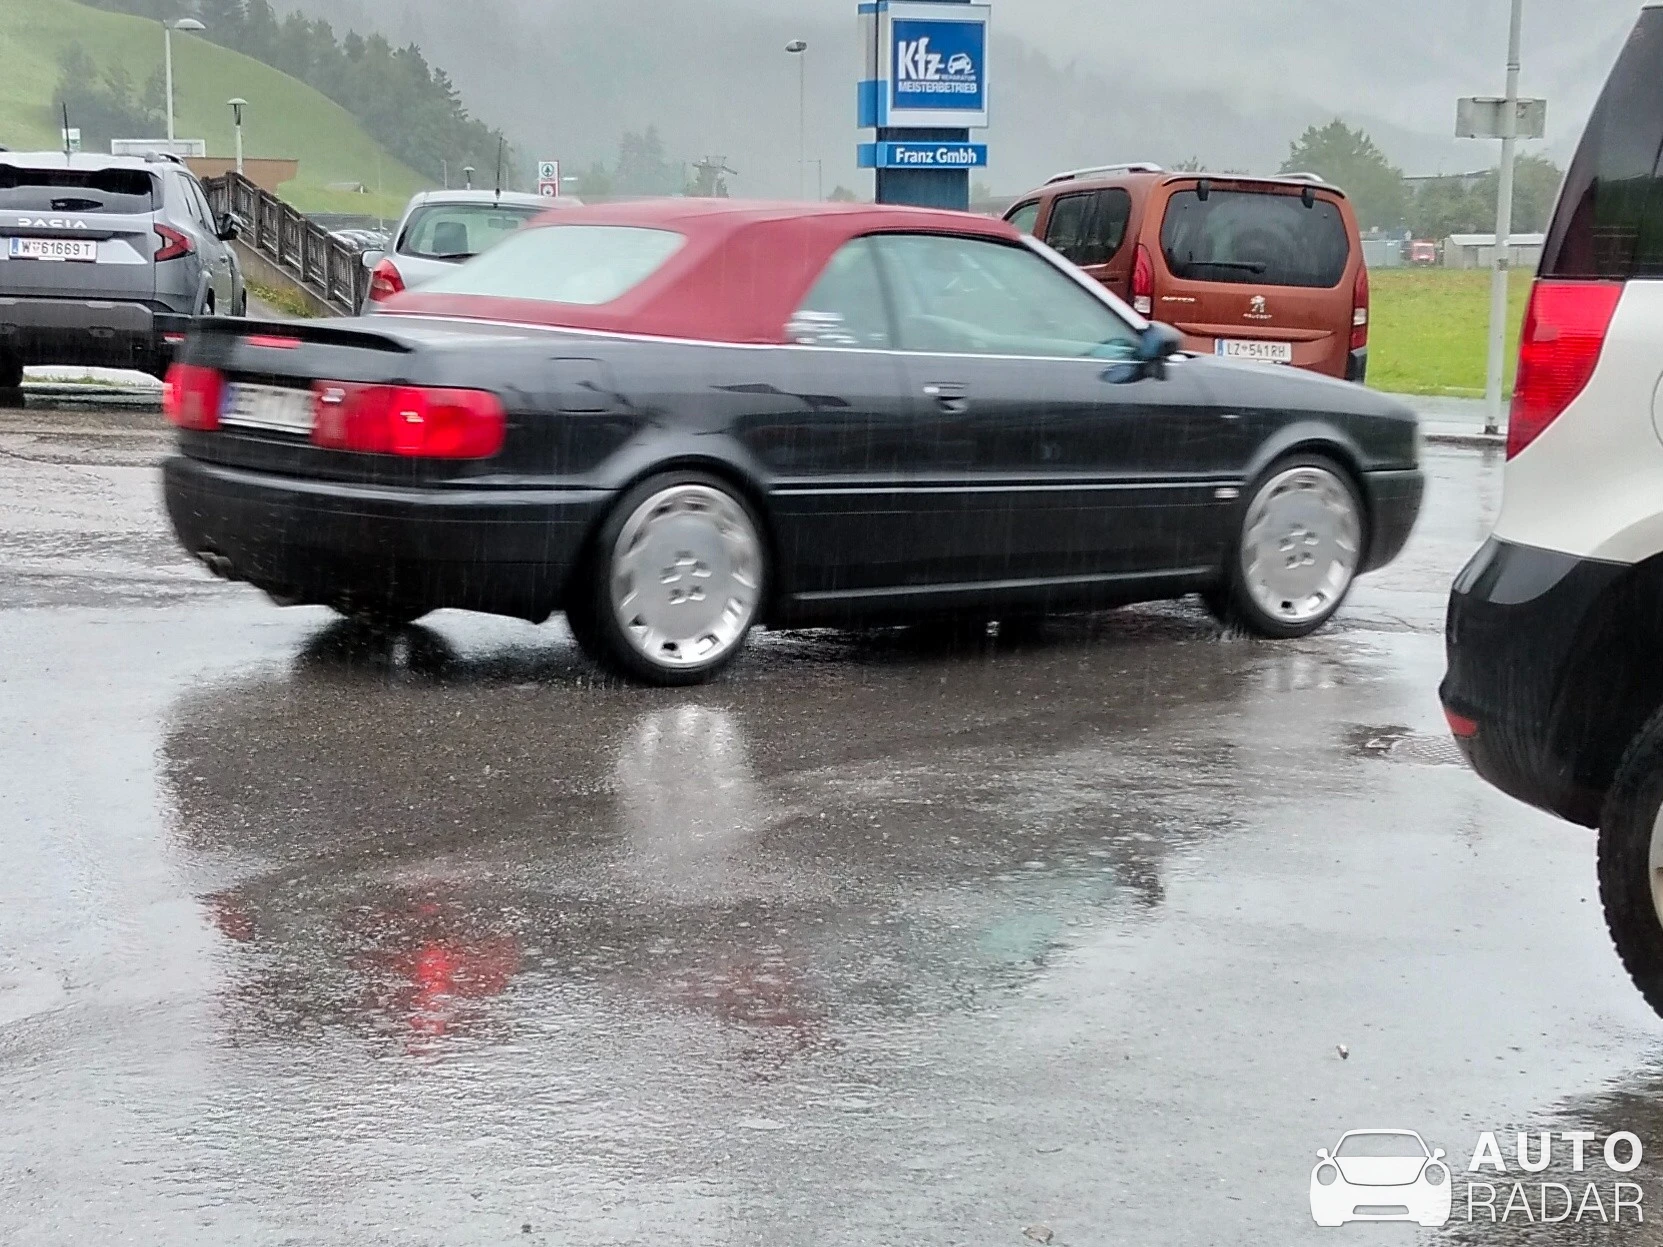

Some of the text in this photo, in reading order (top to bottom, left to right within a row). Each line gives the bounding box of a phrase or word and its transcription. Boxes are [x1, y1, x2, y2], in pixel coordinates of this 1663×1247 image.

[898, 81, 977, 94] MEISTERBETRIEB
[896, 148, 977, 164] Franz Gmbh
[18, 218, 88, 229] DACIA
